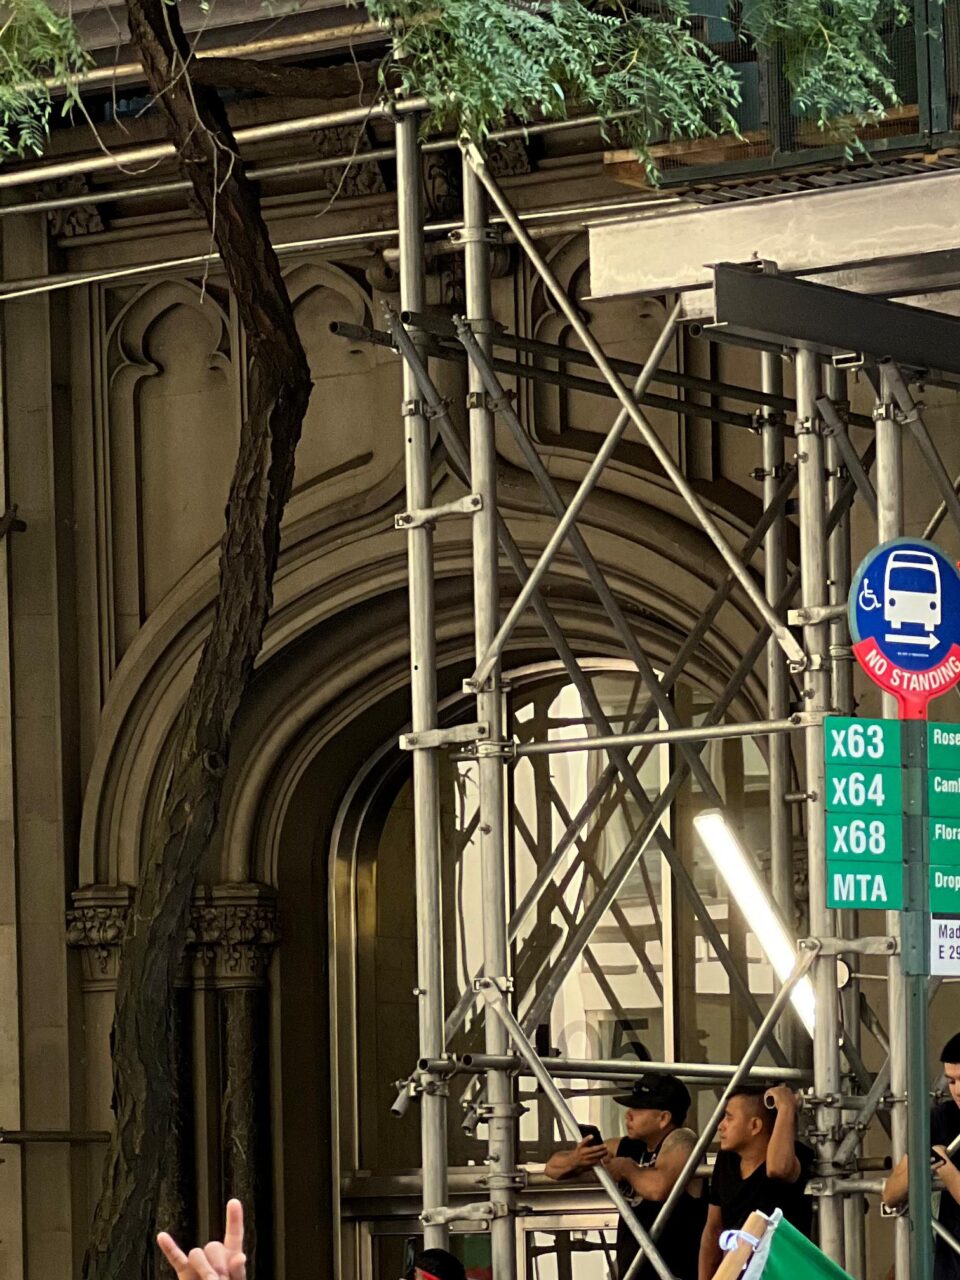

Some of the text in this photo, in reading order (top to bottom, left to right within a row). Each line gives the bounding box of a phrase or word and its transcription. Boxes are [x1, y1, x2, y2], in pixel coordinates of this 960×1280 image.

[865, 649, 888, 675] NO
[833, 873, 887, 902] MTA
[939, 945, 945, 959] E
